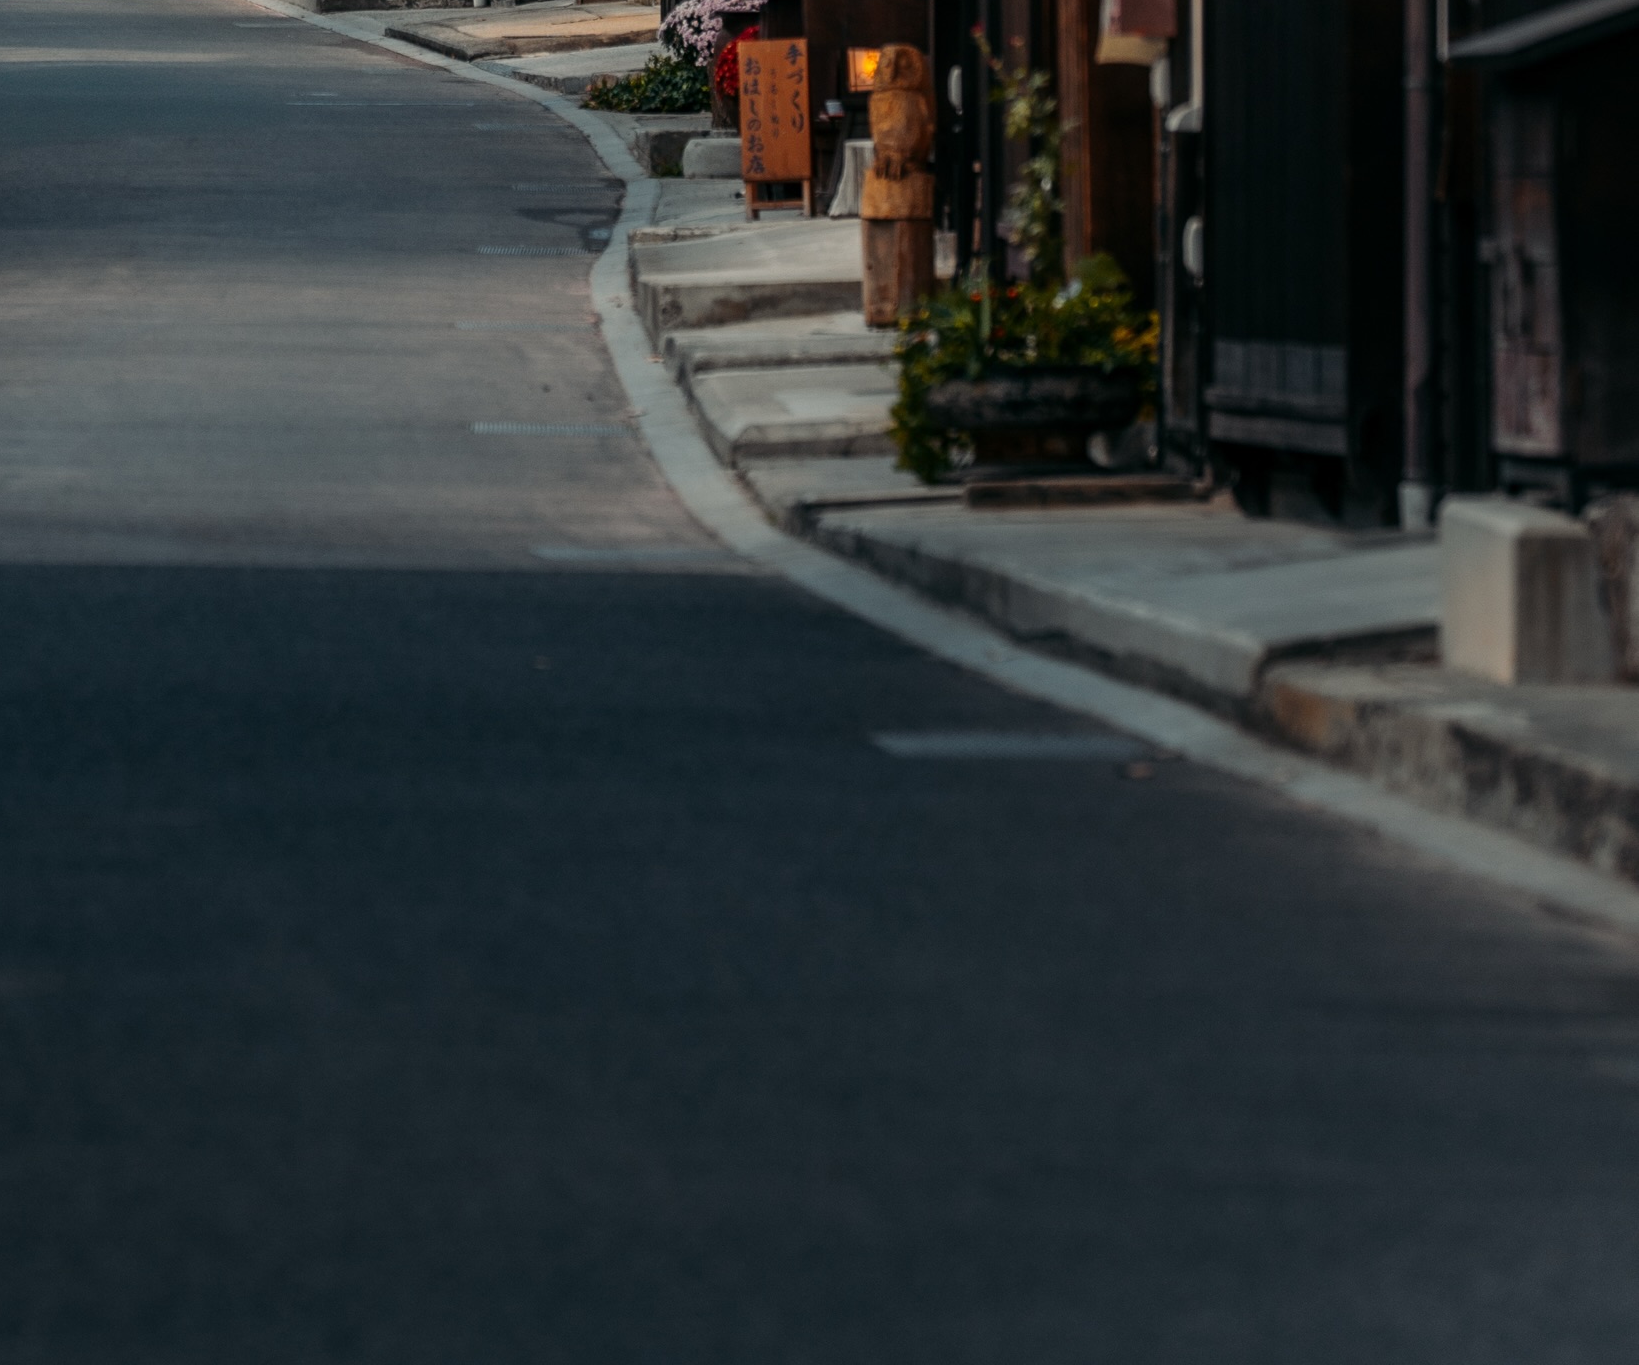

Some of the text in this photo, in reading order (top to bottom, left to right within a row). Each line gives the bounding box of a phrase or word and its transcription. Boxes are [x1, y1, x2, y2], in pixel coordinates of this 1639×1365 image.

[742, 56, 765, 175] おはしのお店
[785, 42, 805, 134] 手づくり
